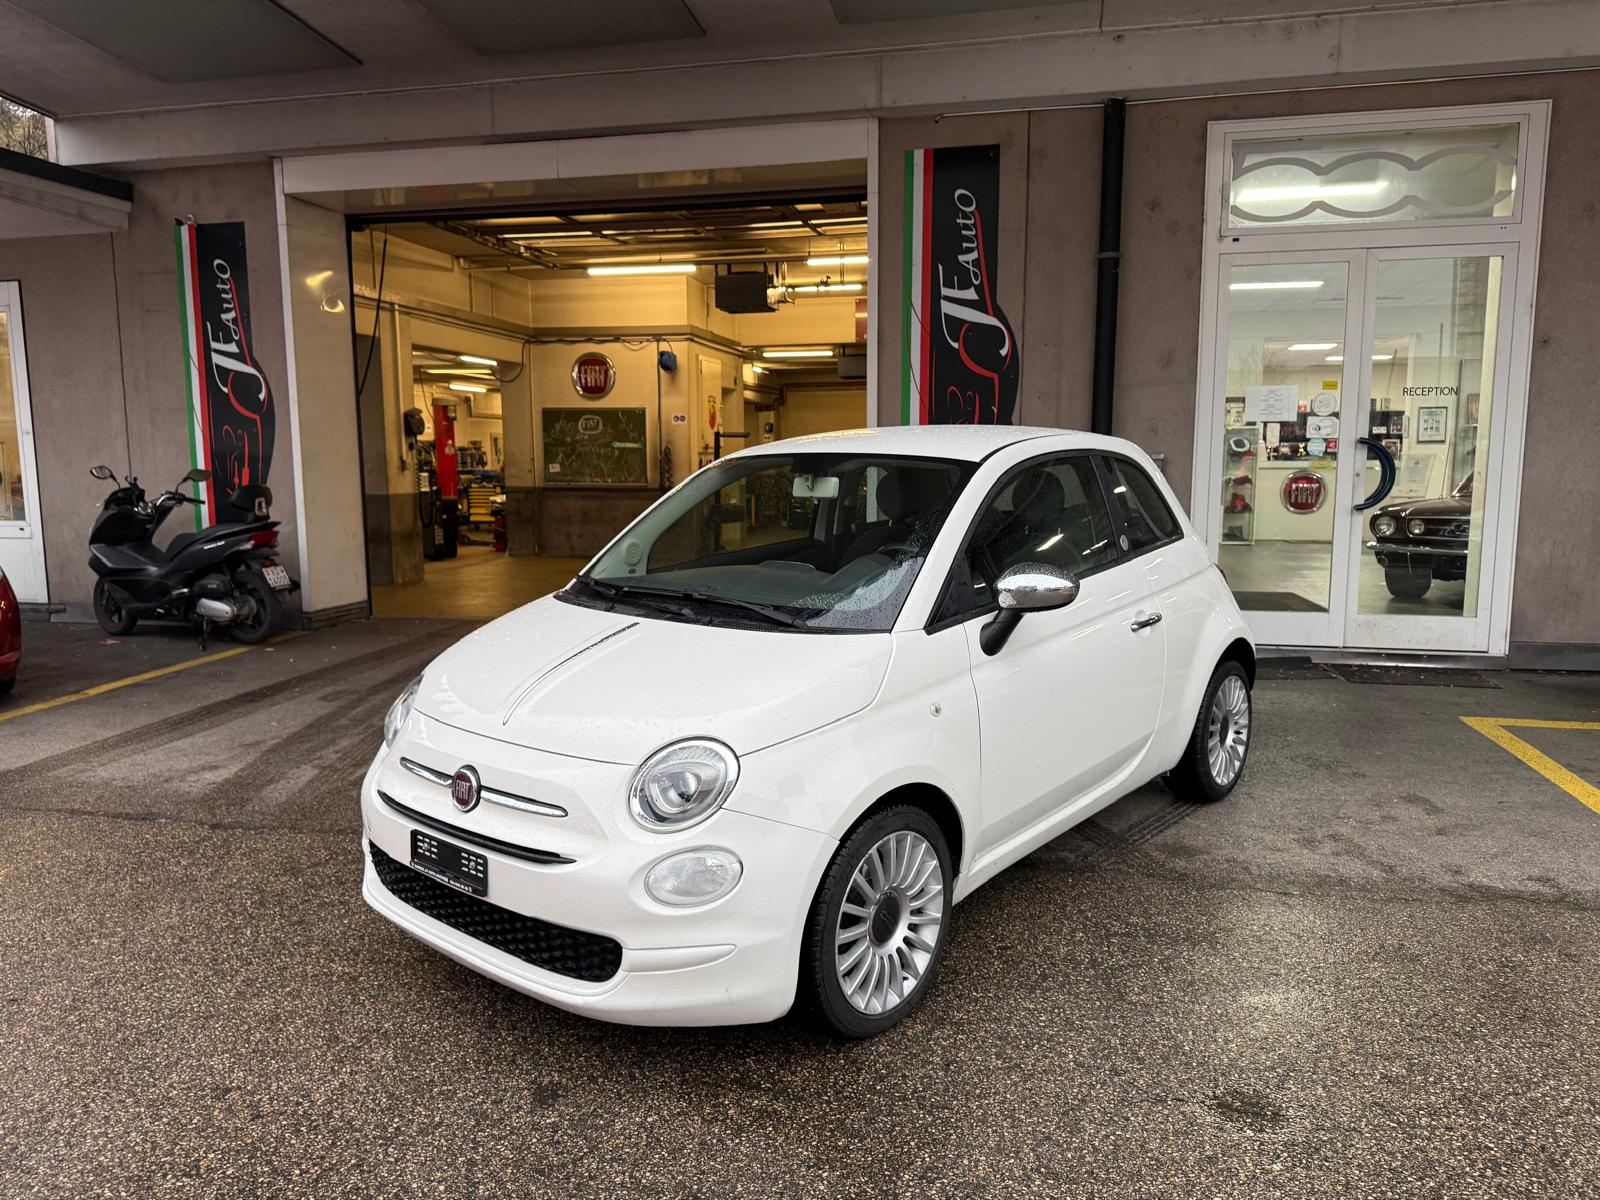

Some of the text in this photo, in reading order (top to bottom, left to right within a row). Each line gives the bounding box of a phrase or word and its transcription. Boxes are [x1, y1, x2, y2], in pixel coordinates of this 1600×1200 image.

[1402, 386, 1458, 396] RECEPTION
[1290, 482, 1320, 503] FIAT
[455, 779, 471, 800] FIAT
